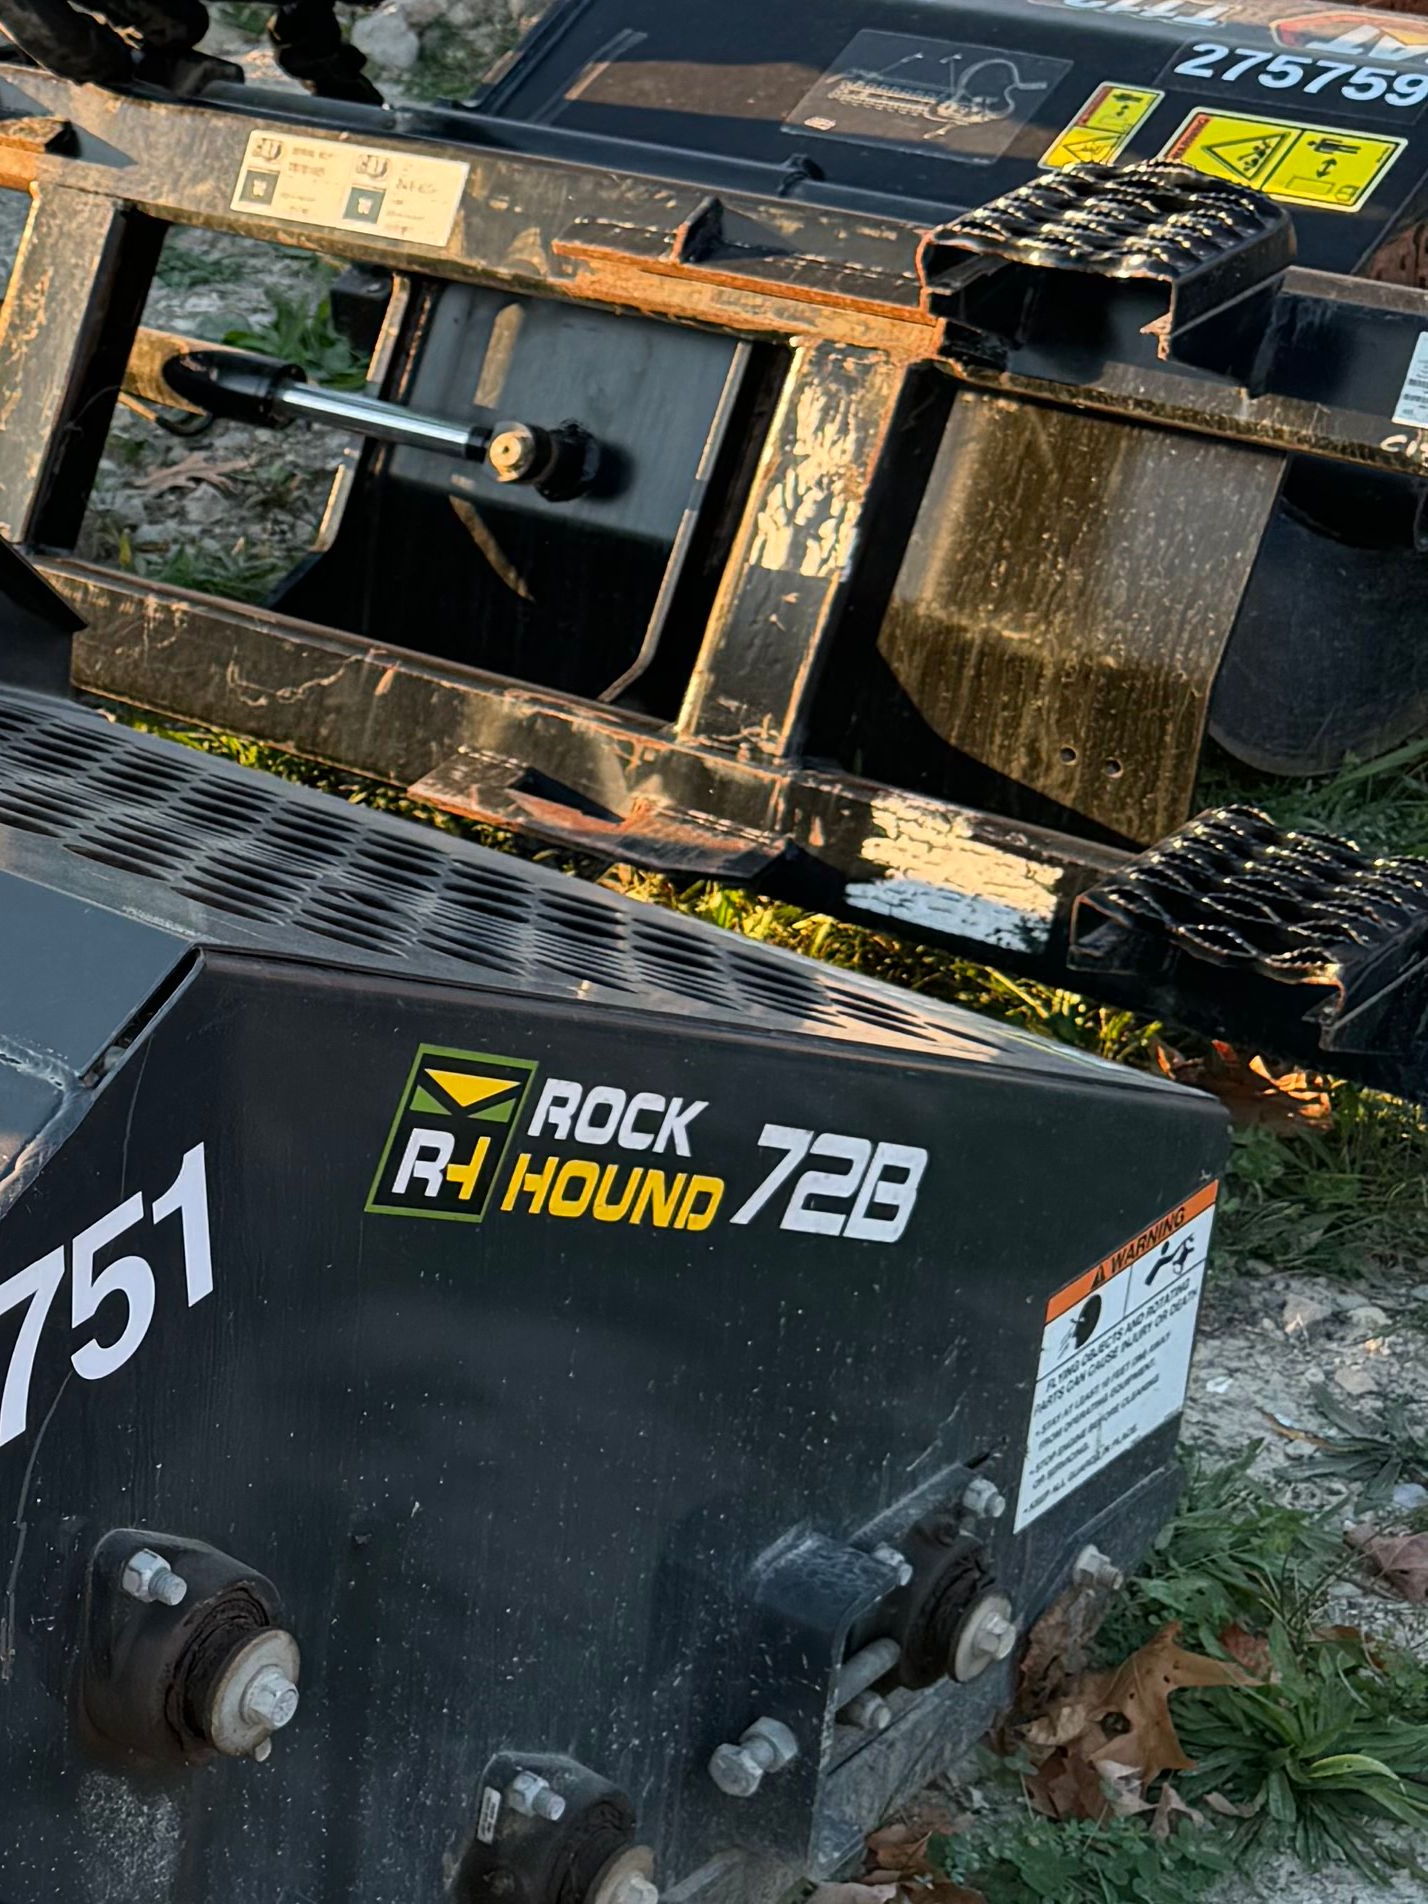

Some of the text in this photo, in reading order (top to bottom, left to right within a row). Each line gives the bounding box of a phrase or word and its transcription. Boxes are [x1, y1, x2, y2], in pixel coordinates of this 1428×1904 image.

[1173, 43, 1428, 107] 275759
[1304, 24, 1428, 63] AT
[529, 1079, 710, 1159] ROCK
[500, 1153, 726, 1232] HOUND
[731, 1122, 931, 1244] 72B
[1109, 1204, 1186, 1275] WARNING
[1033, 1284, 1198, 1418] PARTS CAN CAUSE INJURY OR DEATH
[1045, 1276, 1190, 1394] FLYING OBJECTS AND ROTATING
